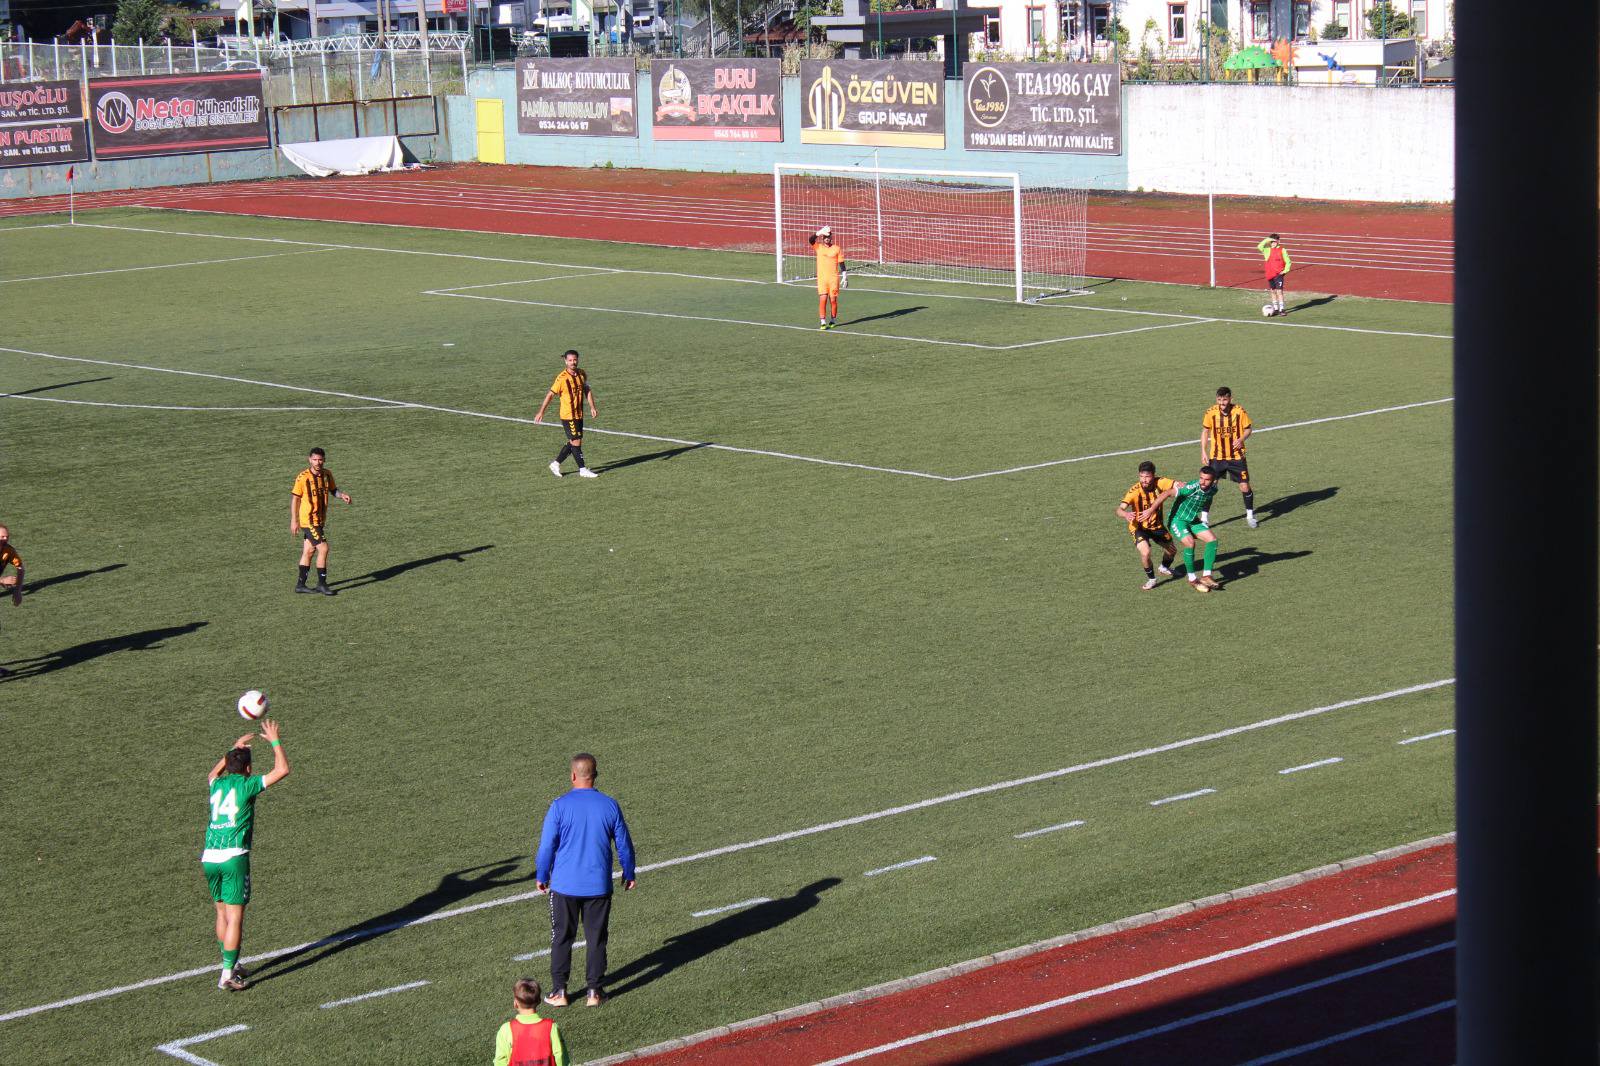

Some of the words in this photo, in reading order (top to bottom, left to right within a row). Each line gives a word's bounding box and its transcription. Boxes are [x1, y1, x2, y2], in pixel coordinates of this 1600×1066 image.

[541, 72, 573, 93] MALKOÇ
[575, 72, 631, 90] KUYUMCULUK
[714, 67, 757, 89] DURU
[847, 74, 937, 105] ÖZGÜVEN
[1015, 72, 1081, 97] TEA1986
[1083, 73, 1112, 102] ÇAY
[0, 85, 68, 111] UŞOĞLU
[136, 97, 196, 121] Neta
[196, 95, 260, 116] Mühendislik
[697, 94, 776, 122] BIÇAKÇILIK
[1, 110, 18, 118] SAN.
[28, 106, 41, 116] TİC.
[42, 107, 57, 115] LTD.
[858, 110, 887, 125] GRUP
[888, 108, 928, 130] İNŞAAT
[1030, 103, 1052, 123] TİC.
[1053, 107, 1077, 123] LTD.
[1078, 104, 1099, 127] ŞTİ.
[14, 125, 73, 145] PLASTİK
[1007, 131, 1026, 147] BERİ
[1027, 133, 1047, 147] AYNI
[1048, 134, 1063, 148] TAT
[1064, 134, 1084, 149] AYNI
[1084, 132, 1114, 150] KALİTE
[3, 149, 21, 157] SAN.
[209, 787, 240, 823] 14
